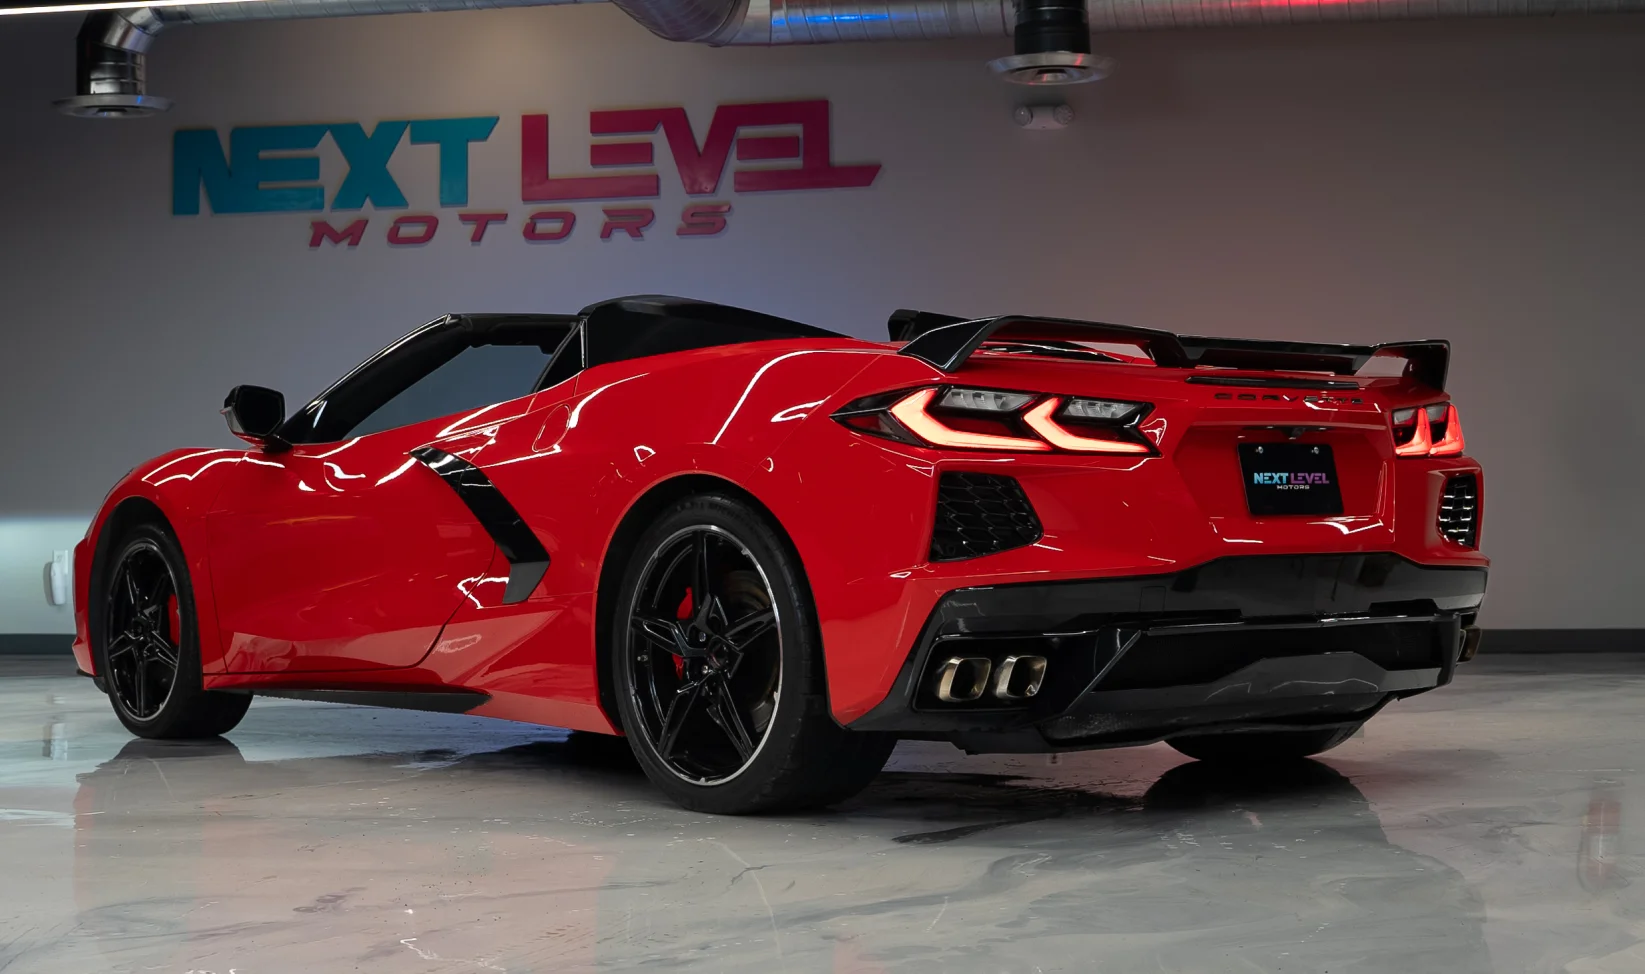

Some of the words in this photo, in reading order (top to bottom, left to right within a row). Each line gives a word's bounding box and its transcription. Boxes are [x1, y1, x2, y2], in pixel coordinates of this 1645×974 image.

[172, 116, 499, 215] NEXT
[521, 99, 882, 202] LEVEL
[309, 204, 732, 248] MOTORS
[1253, 472, 1289, 484] NEXT
[1290, 472, 1330, 484] LEVEL
